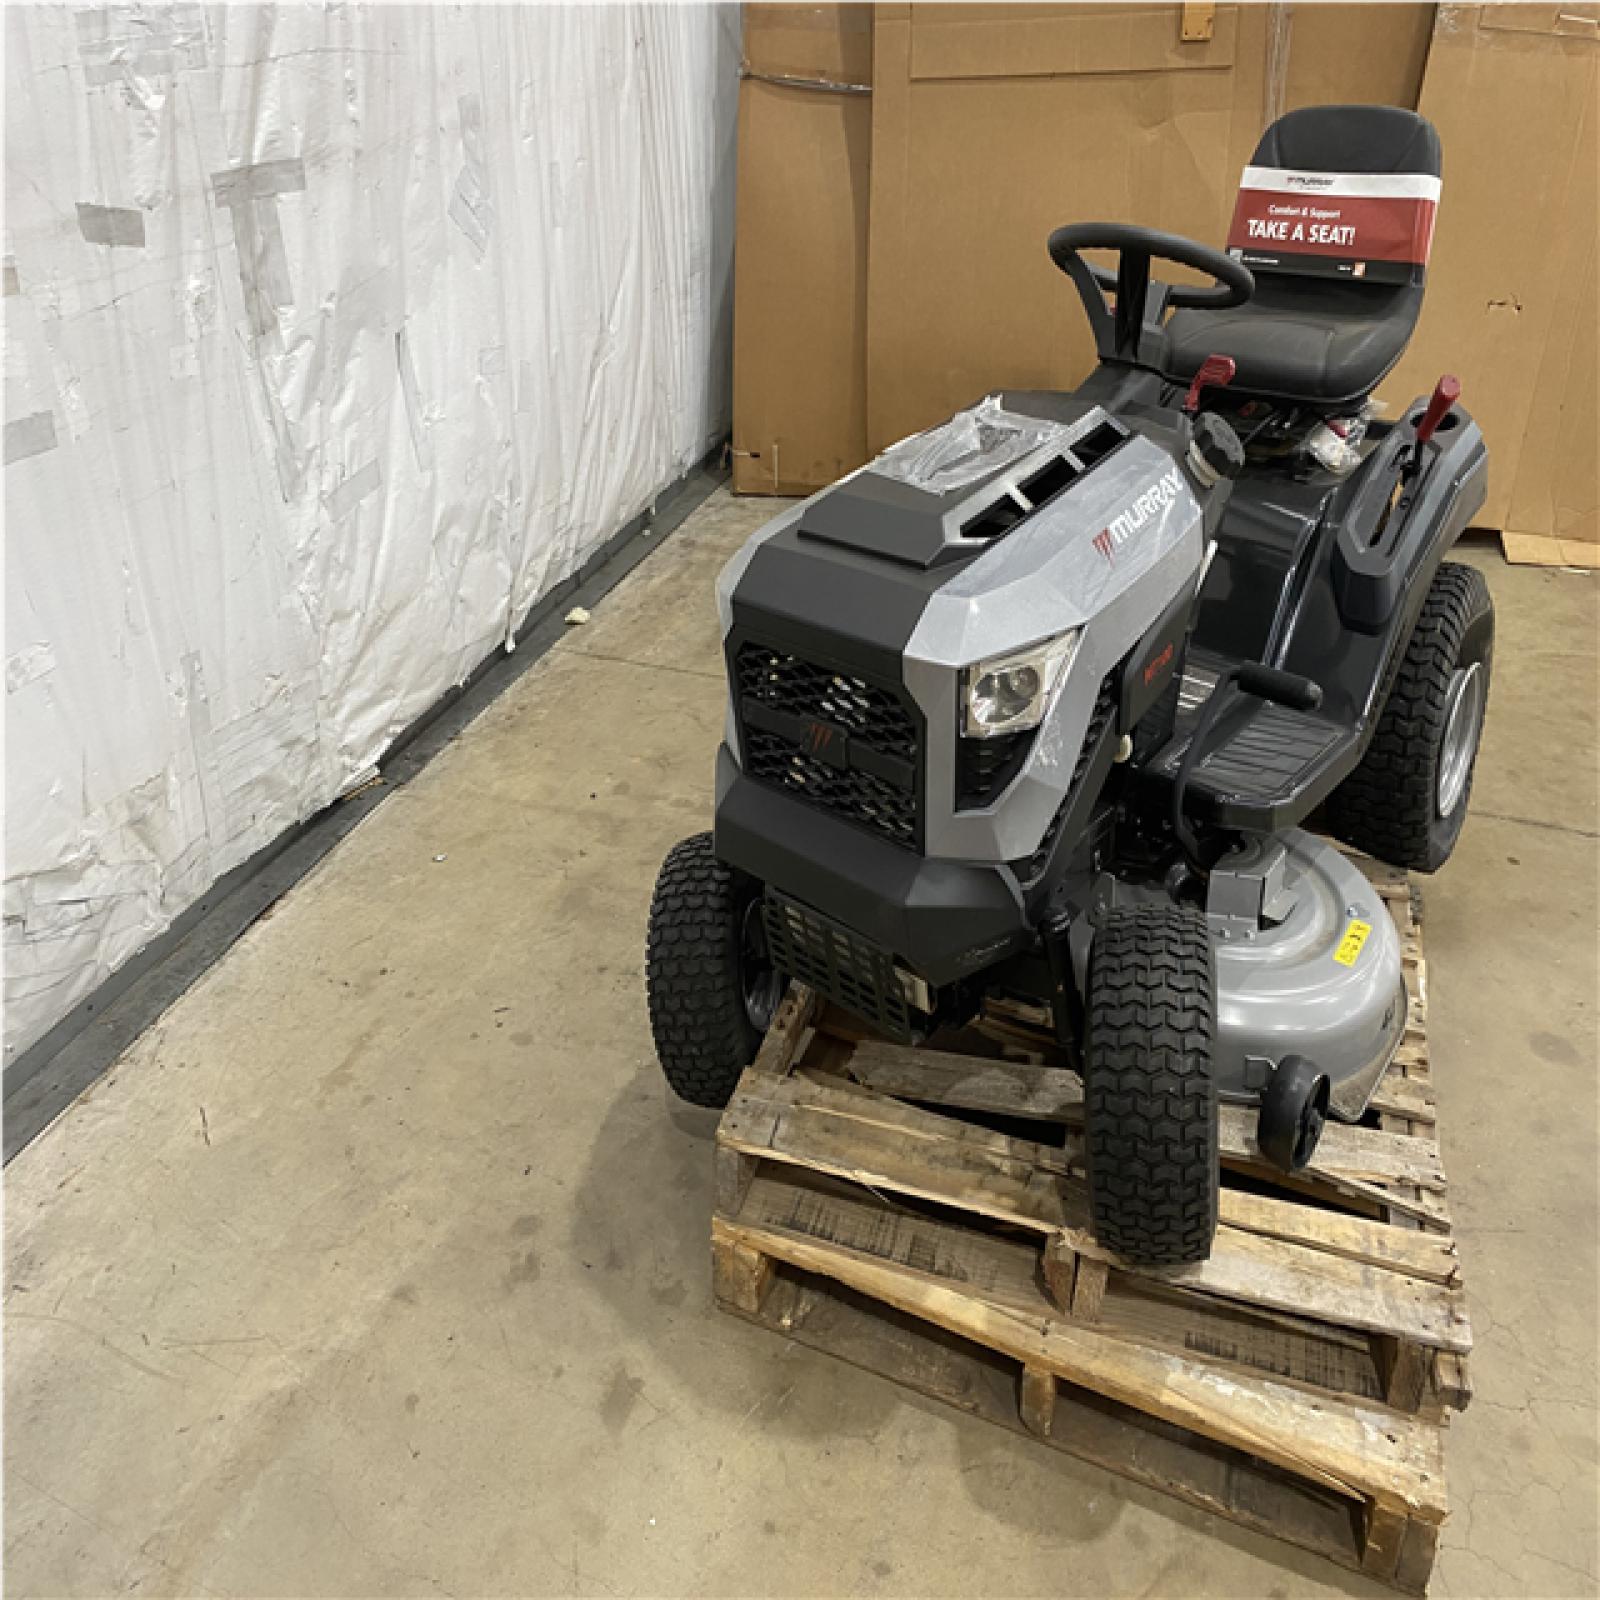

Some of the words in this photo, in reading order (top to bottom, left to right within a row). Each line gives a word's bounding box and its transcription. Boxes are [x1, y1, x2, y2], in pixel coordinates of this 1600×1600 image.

[1248, 219, 1289, 241] TAKE
[1291, 222, 1304, 241] A
[1308, 224, 1356, 246] SEAT!
[1109, 467, 1183, 543] MURRAY
